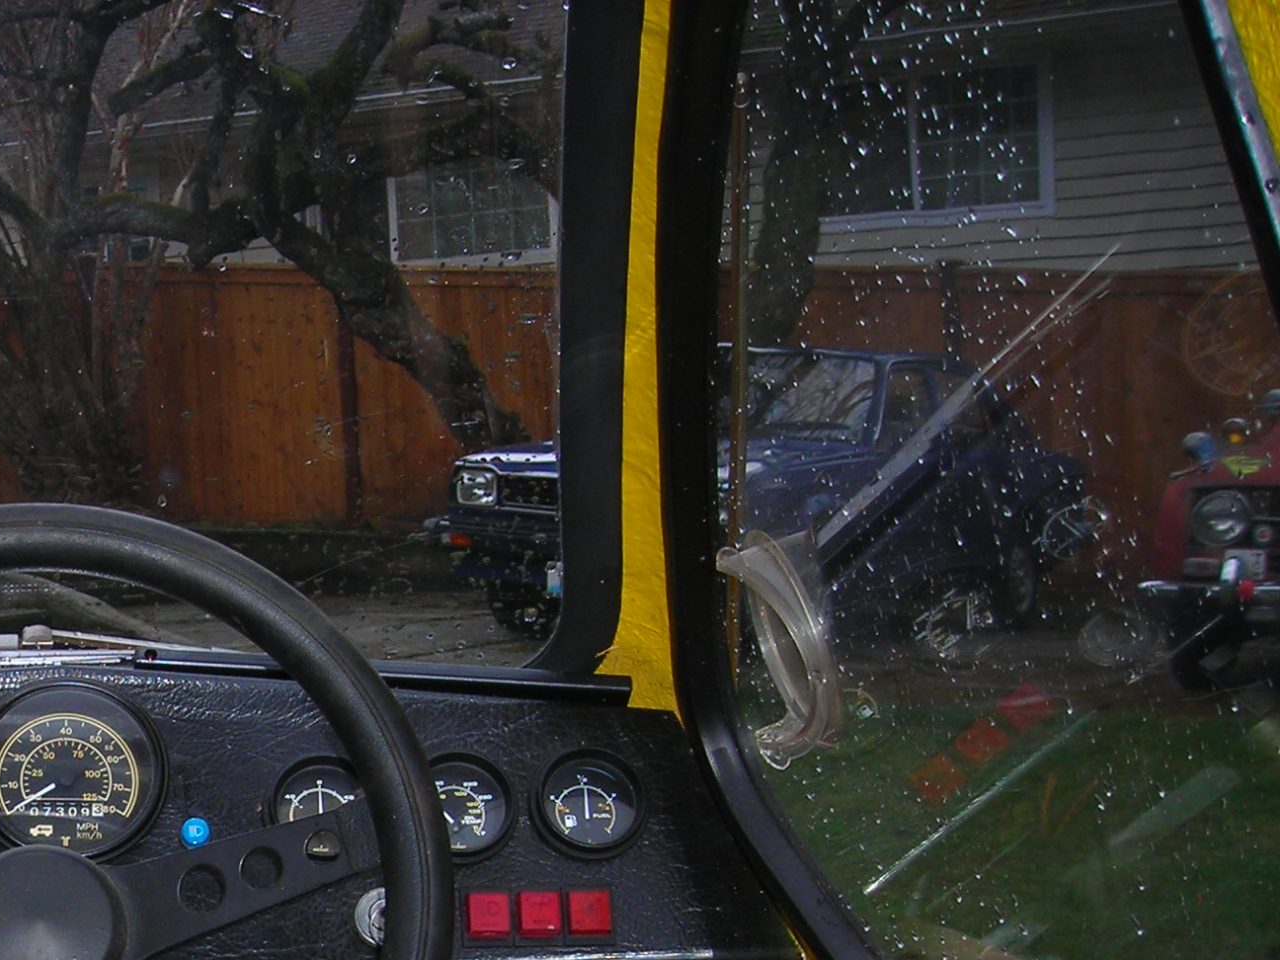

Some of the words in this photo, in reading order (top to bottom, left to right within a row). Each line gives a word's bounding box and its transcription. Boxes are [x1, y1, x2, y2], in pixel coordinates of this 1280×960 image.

[60, 727, 73, 735] 40
[30, 734, 42, 743] 30
[89, 736, 102, 744] 50
[14, 754, 26, 762] 20
[43, 751, 55, 760] 50
[72, 750, 85, 759] 75
[107, 756, 120, 764] 60
[31, 769, 44, 777] 25
[84, 771, 100, 779] 100
[8, 781, 19, 789] 10
[112, 784, 124, 792] 70
[82, 793, 98, 801] 125
[76, 823, 99, 831] MPH
[76, 831, 102, 839] km/h
